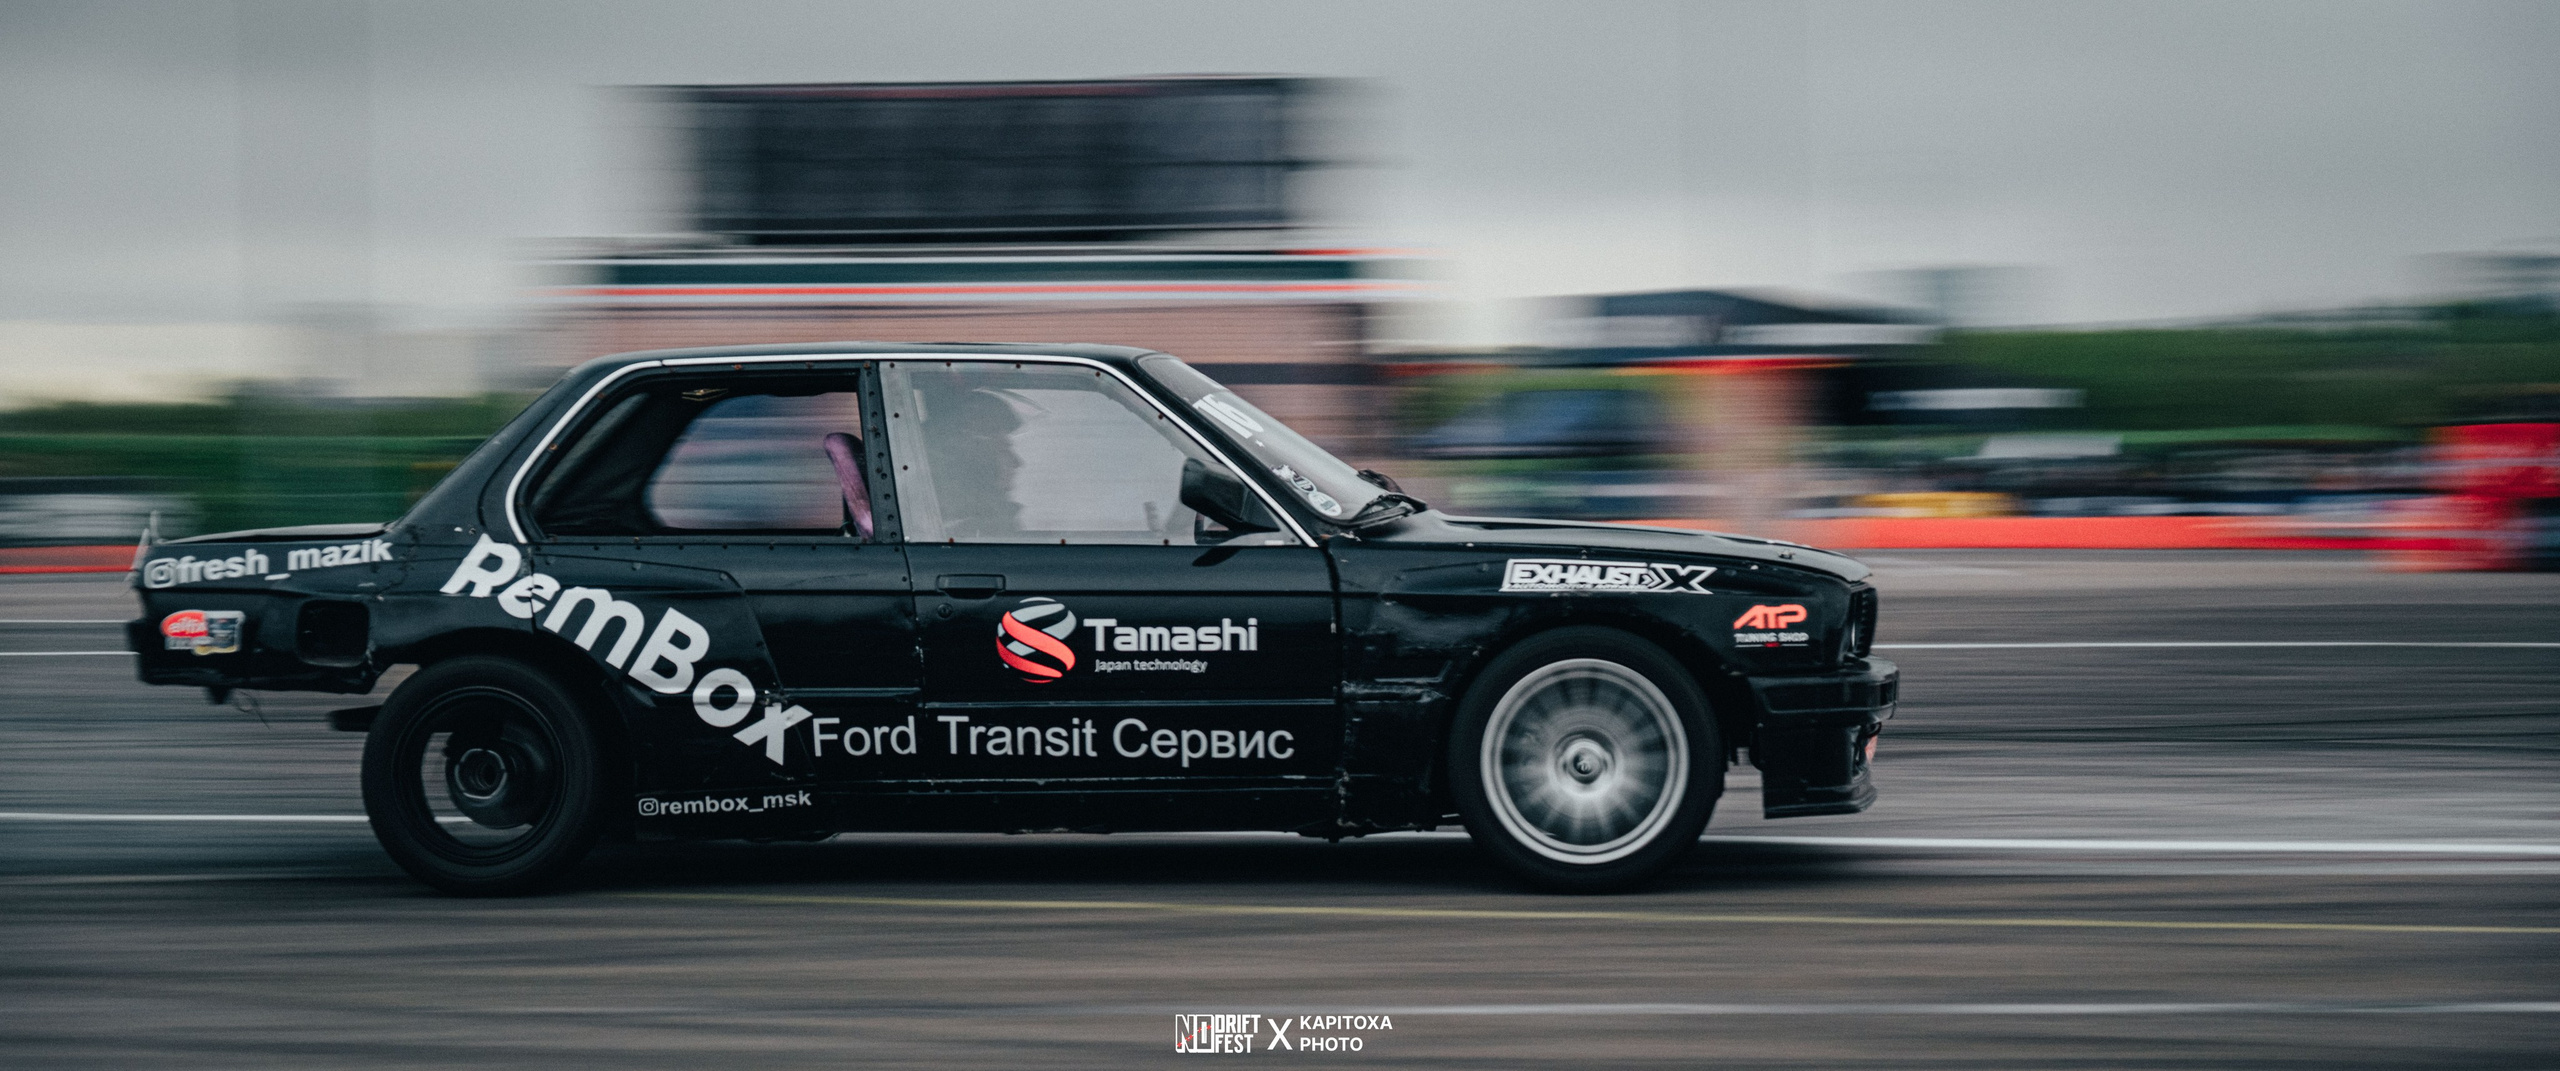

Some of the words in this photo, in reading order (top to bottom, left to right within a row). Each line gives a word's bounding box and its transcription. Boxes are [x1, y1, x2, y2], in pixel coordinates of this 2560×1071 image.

[175, 539, 393, 584] fresh_mazik
[1512, 565, 1642, 585] EXHAUST
[1733, 604, 1808, 629] ATP
[1083, 618, 1258, 651] Tamashi
[1734, 633, 1777, 643] TUNING
[1778, 632, 1809, 642] SHOP
[440, 533, 813, 765] RemBox
[1095, 659, 1132, 673] Japan
[1133, 658, 1208, 673] technology
[813, 716, 917, 757] Ford
[937, 715, 1098, 757] Transit
[1112, 719, 1295, 767] Сервис
[661, 790, 812, 815] rembox_msk
